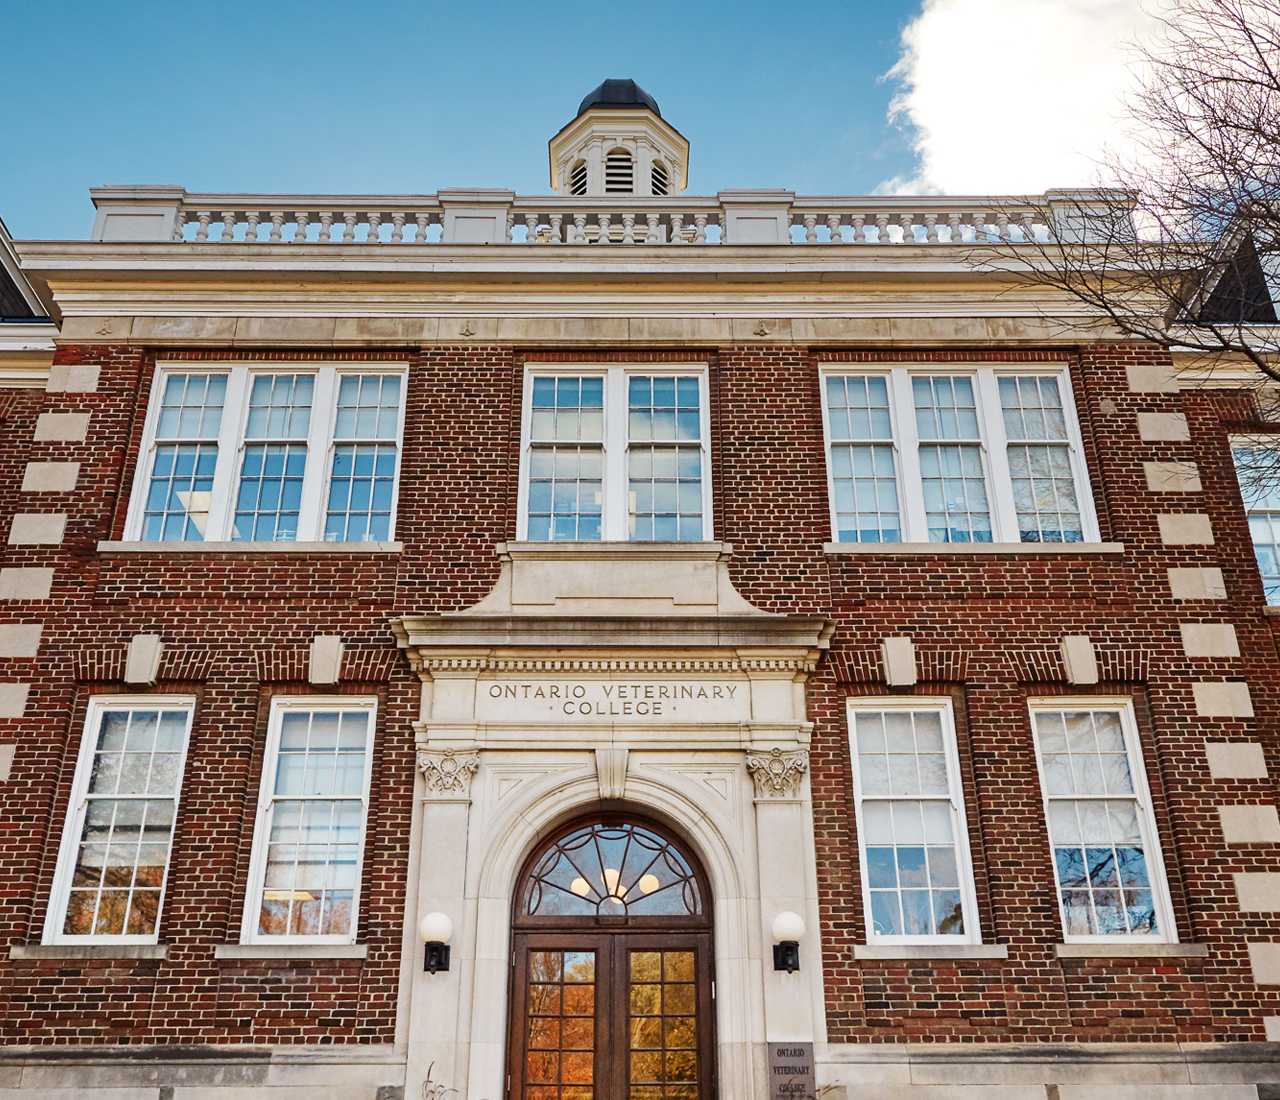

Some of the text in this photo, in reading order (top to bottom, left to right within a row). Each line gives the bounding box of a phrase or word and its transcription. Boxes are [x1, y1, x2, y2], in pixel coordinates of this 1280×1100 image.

[489, 685, 738, 699] ONTARIO VETERINARY
[563, 702, 663, 715] COLLEGE
[777, 1048, 805, 1057] ONTARIO
[773, 1066, 809, 1075] VETERINARY
